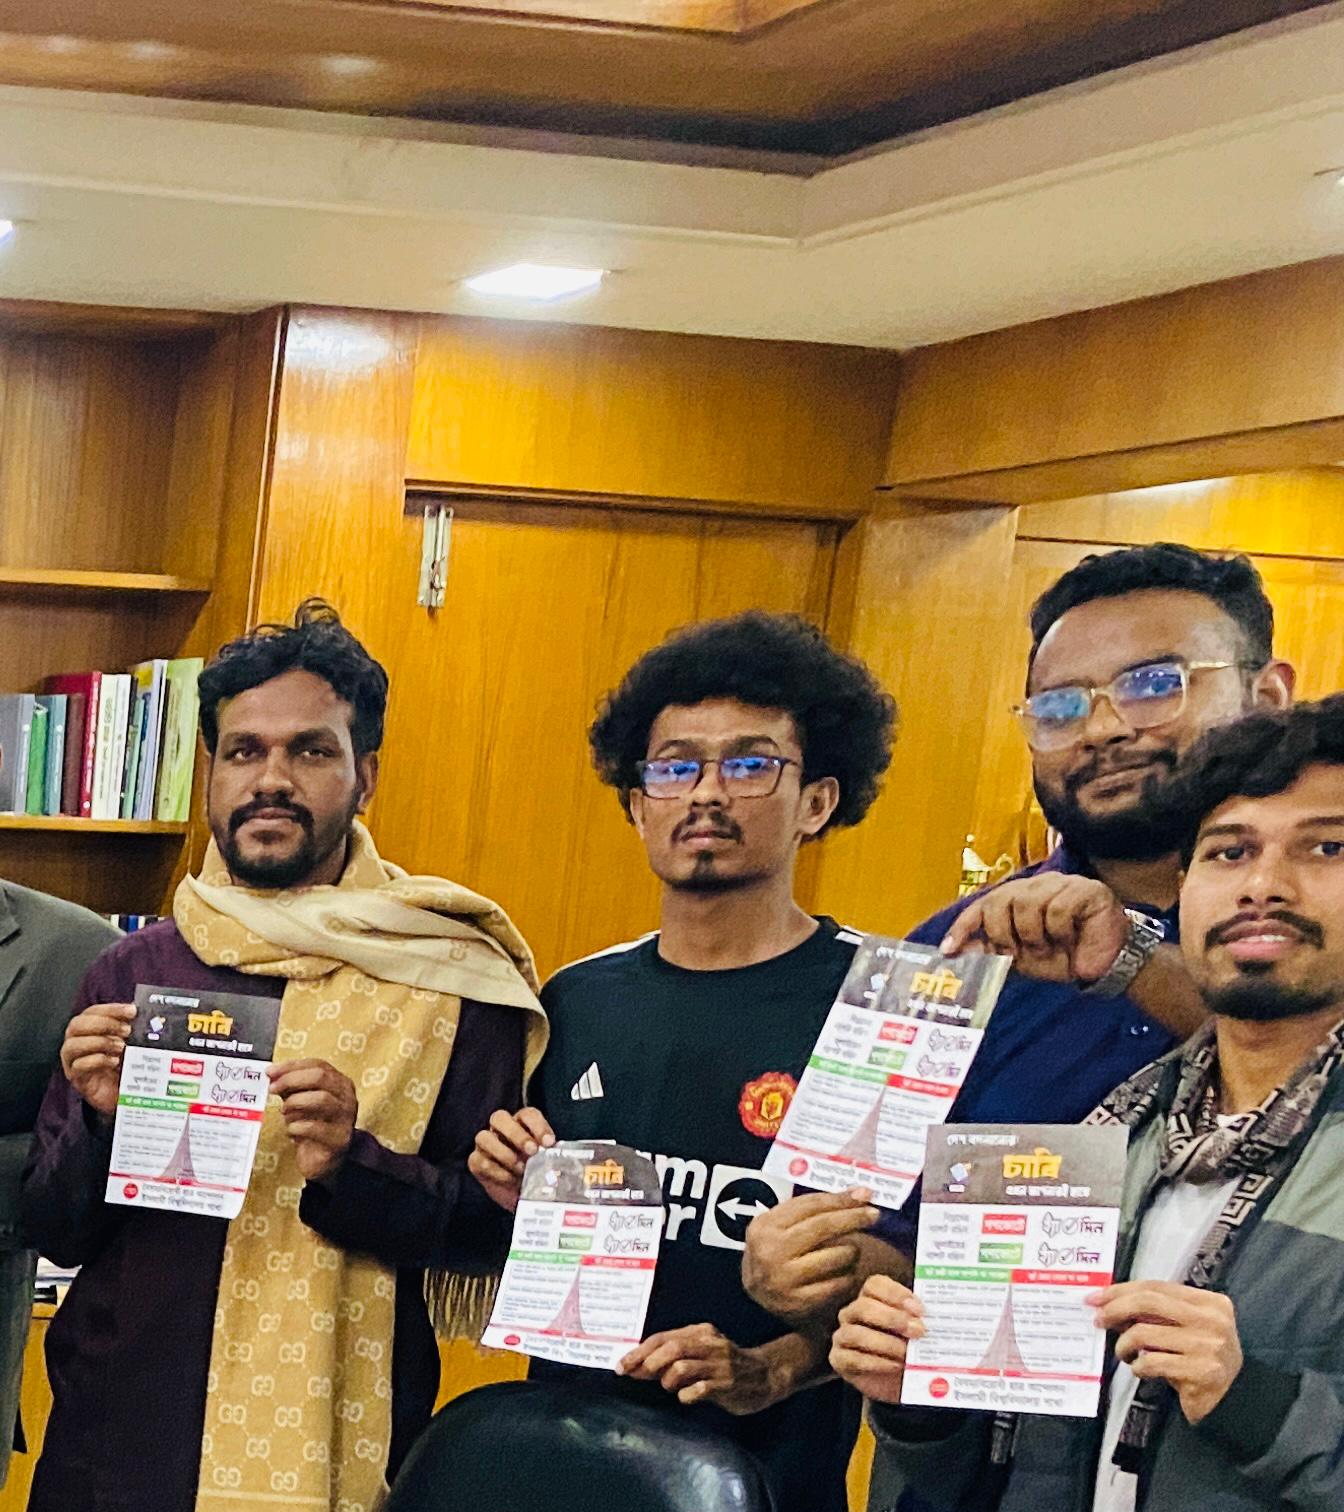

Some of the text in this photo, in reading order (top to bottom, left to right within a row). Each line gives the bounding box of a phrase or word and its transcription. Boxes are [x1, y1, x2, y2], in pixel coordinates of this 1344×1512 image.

[187, 1010, 233, 1035] চাবি
[1003, 1148, 1062, 1179] চাবি
[1080, 1216, 1104, 1234] দিন
[1076, 1248, 1100, 1264] দিন
